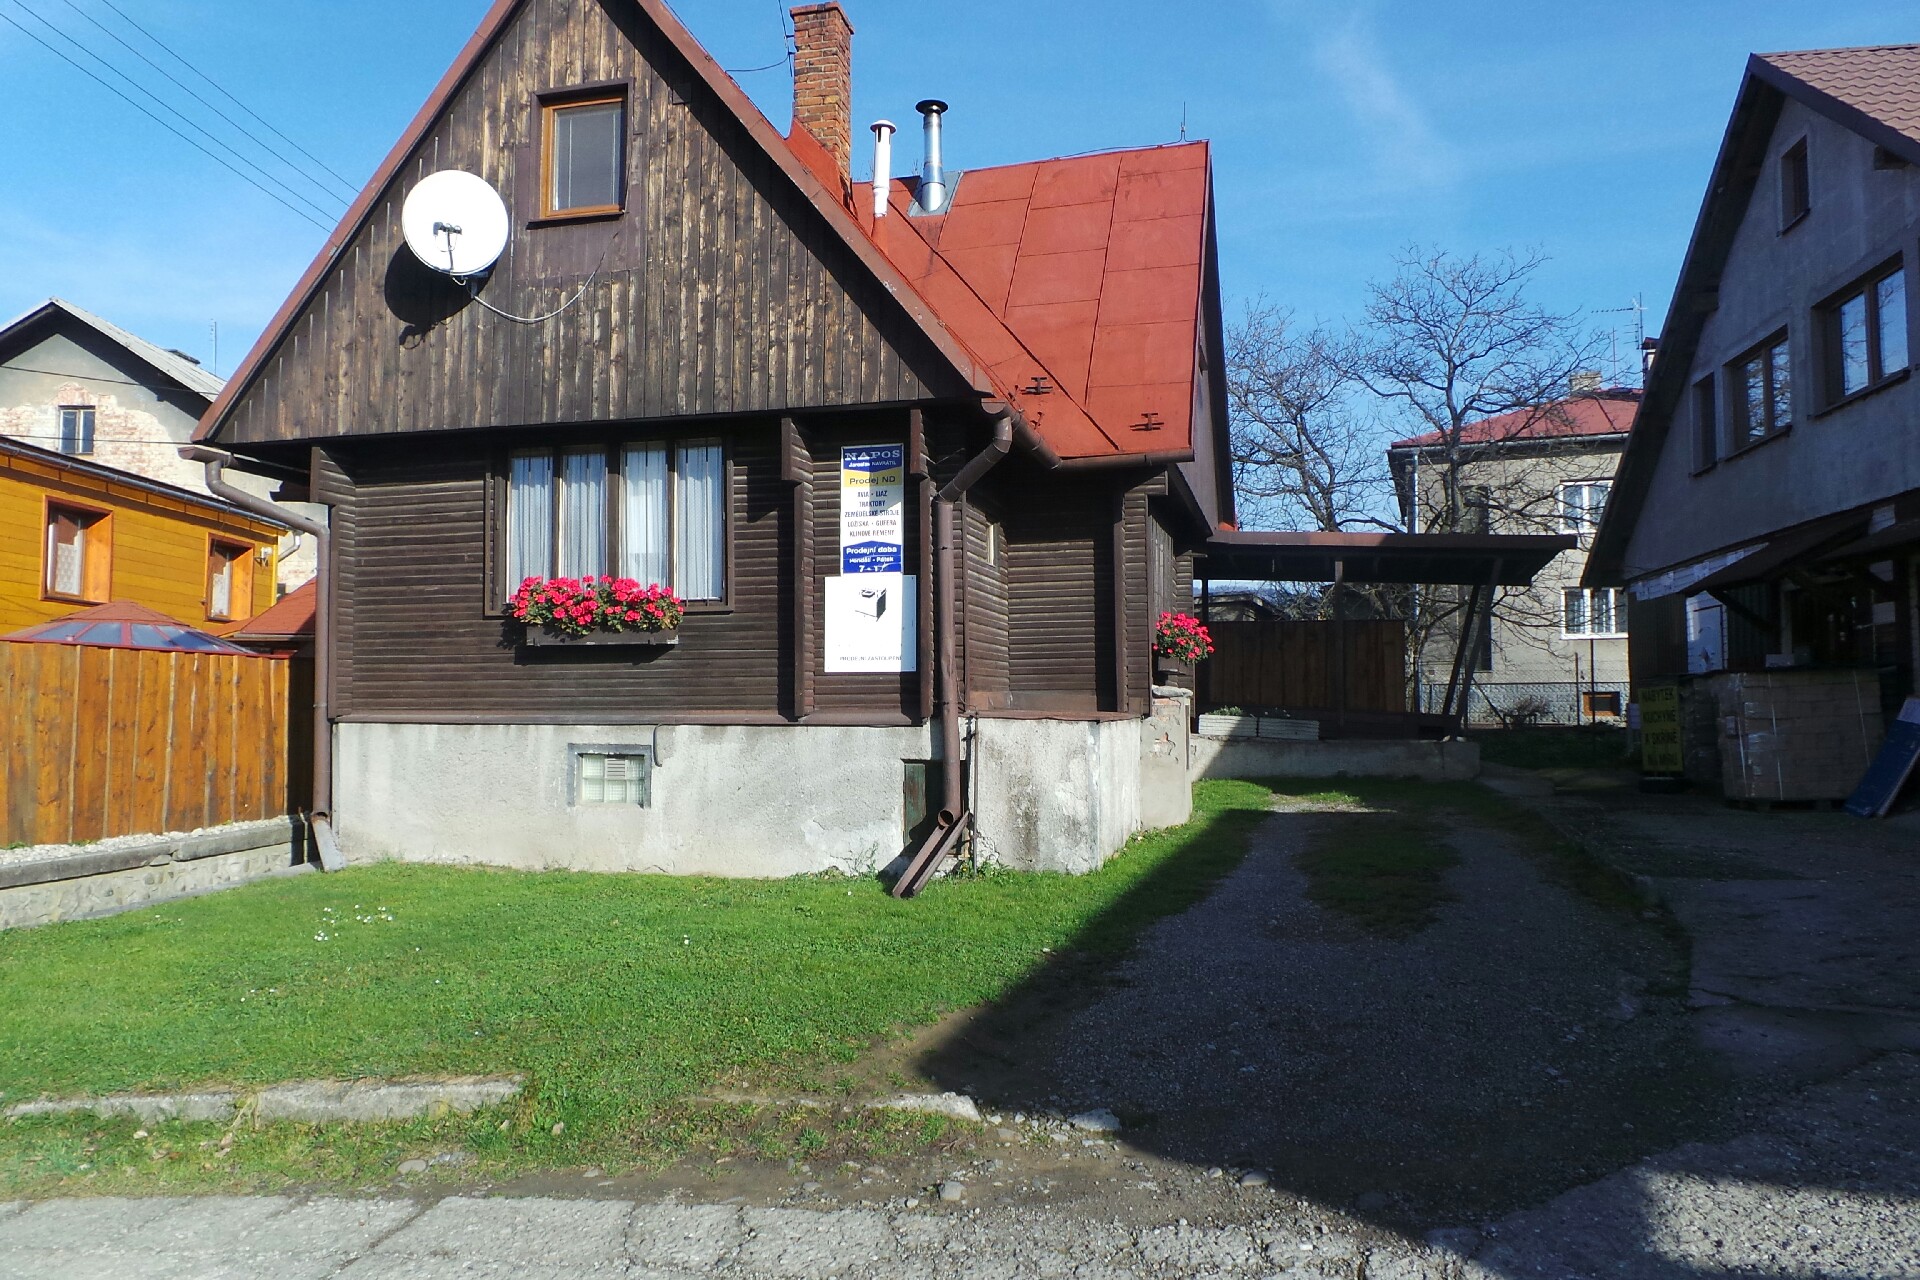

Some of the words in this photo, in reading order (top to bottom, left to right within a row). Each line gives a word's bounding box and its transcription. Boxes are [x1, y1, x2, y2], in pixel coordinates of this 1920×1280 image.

[845, 449, 900, 460] NAPOS
[849, 476, 879, 485] Prodej
[881, 475, 896, 483] ND
[846, 546, 877, 555] Prodejní
